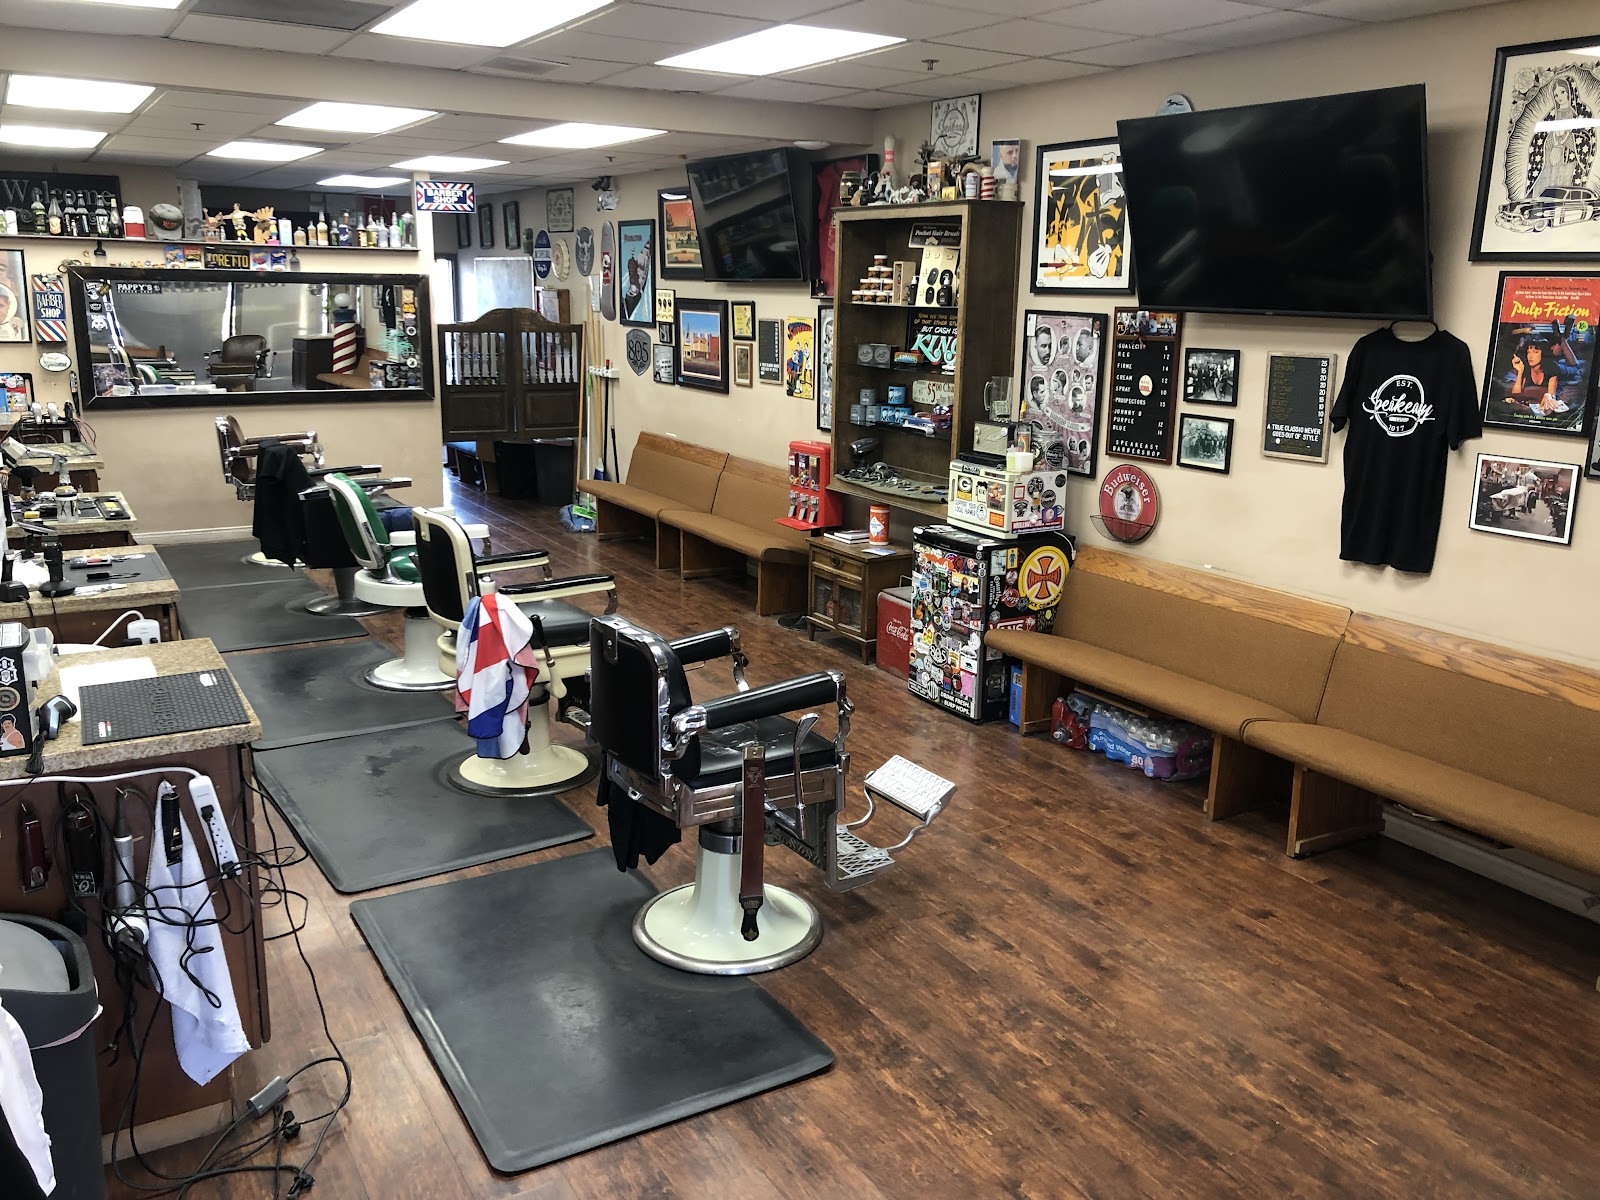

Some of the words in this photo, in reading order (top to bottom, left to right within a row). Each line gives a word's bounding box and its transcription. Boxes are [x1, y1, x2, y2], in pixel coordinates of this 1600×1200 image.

[427, 189, 463, 198] BARBER
[40, 307, 61, 319] SHOP
[1510, 300, 1543, 319] Pulp
[1543, 301, 1590, 319] Fiction
[934, 326, 951, 334] CASH
[628, 339, 649, 363] 805
[1396, 380, 1414, 389] EST.
[1318, 388, 1326, 396] 20
[1113, 416, 1135, 425] PURPLE
[1318, 417, 1323, 425] 3
[1112, 424, 1127, 432] BLUE
[1271, 423, 1285, 431] TRUE
[1284, 425, 1304, 433] CLASSIC
[1304, 427, 1321, 435] NEVER
[1388, 424, 1405, 432] 2017
[1272, 430, 1285, 438] GOES
[1284, 431, 1294, 439] OUT
[1302, 433, 1319, 442] STYLE
[1112, 445, 1161, 457] BARBERSHOP
[1103, 472, 1151, 503] Budweiser
[1038, 590, 1062, 609] COMPANY
[930, 643, 948, 664] 805
[940, 691, 956, 701] DRINK
[1115, 744, 1132, 757] Water
[1131, 754, 1144, 766] 80
